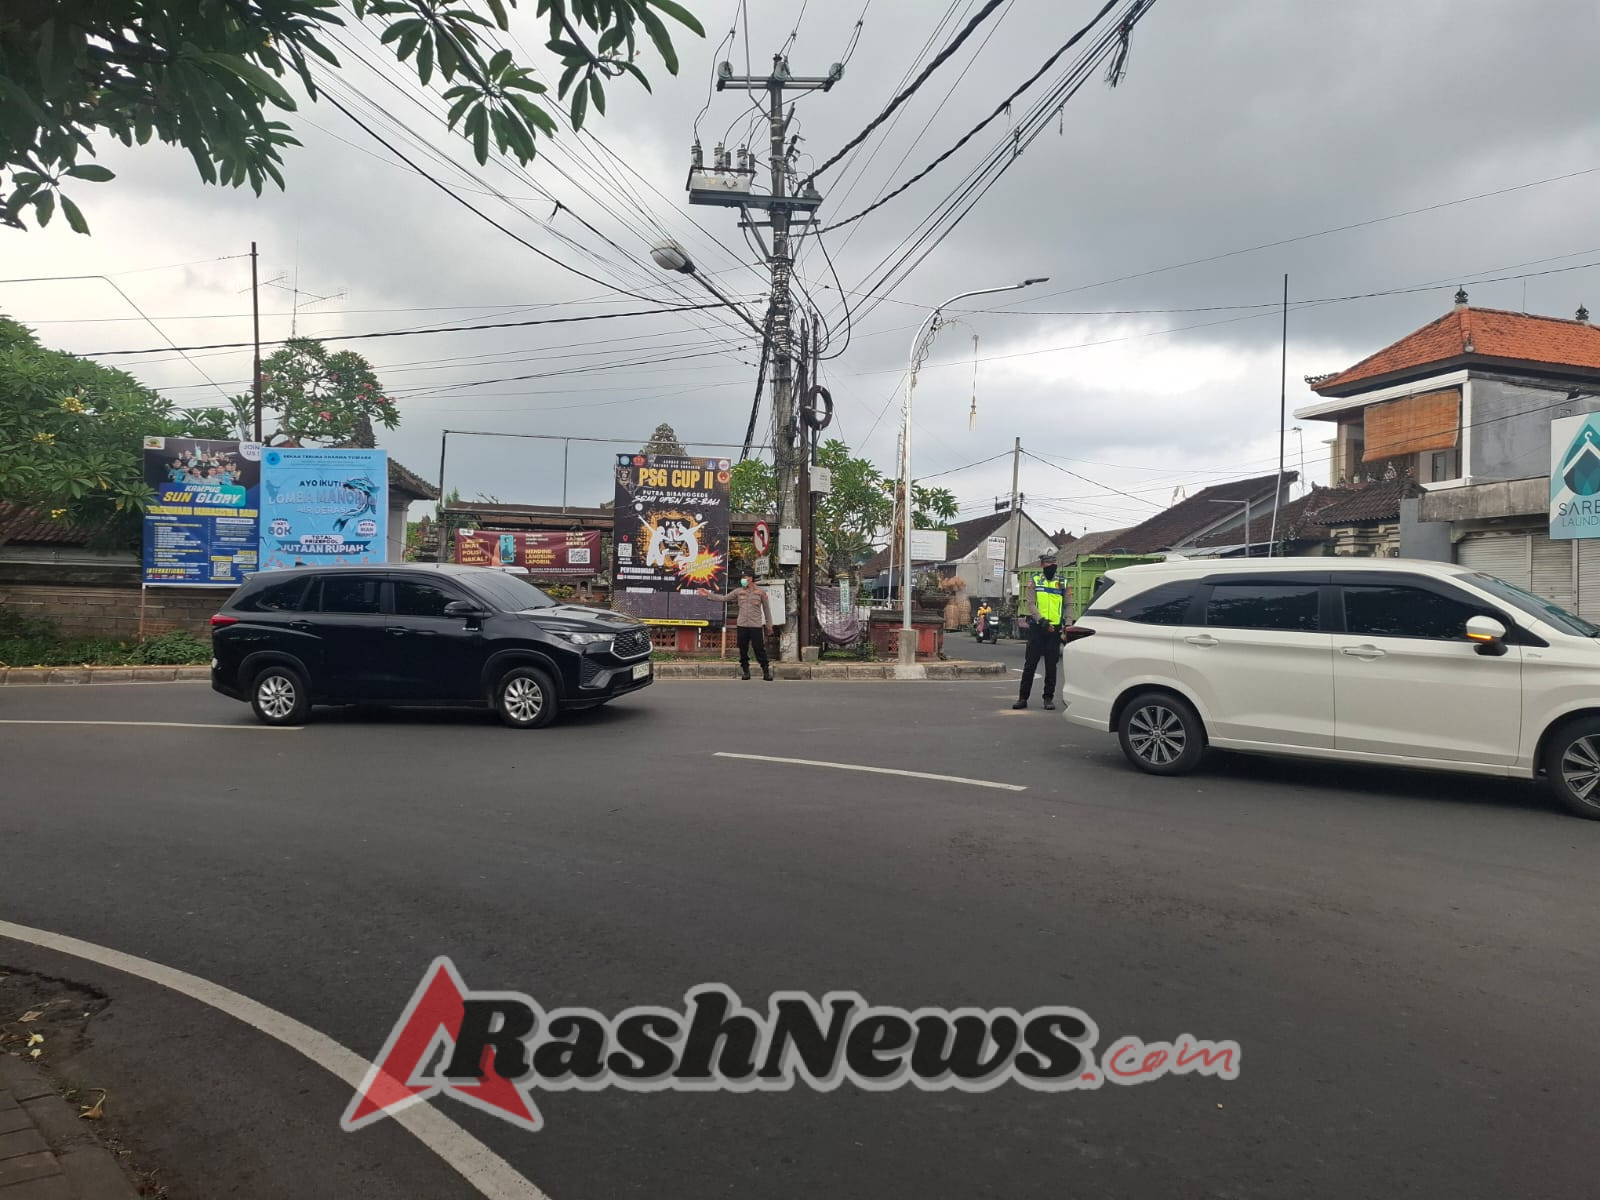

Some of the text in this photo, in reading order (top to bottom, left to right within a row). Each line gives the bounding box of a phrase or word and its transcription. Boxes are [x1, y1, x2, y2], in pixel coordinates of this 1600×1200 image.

[639, 468, 714, 489] PSG CUP II
[162, 491, 242, 504] SUN GLORY
[325, 545, 363, 553] RUPIAH
